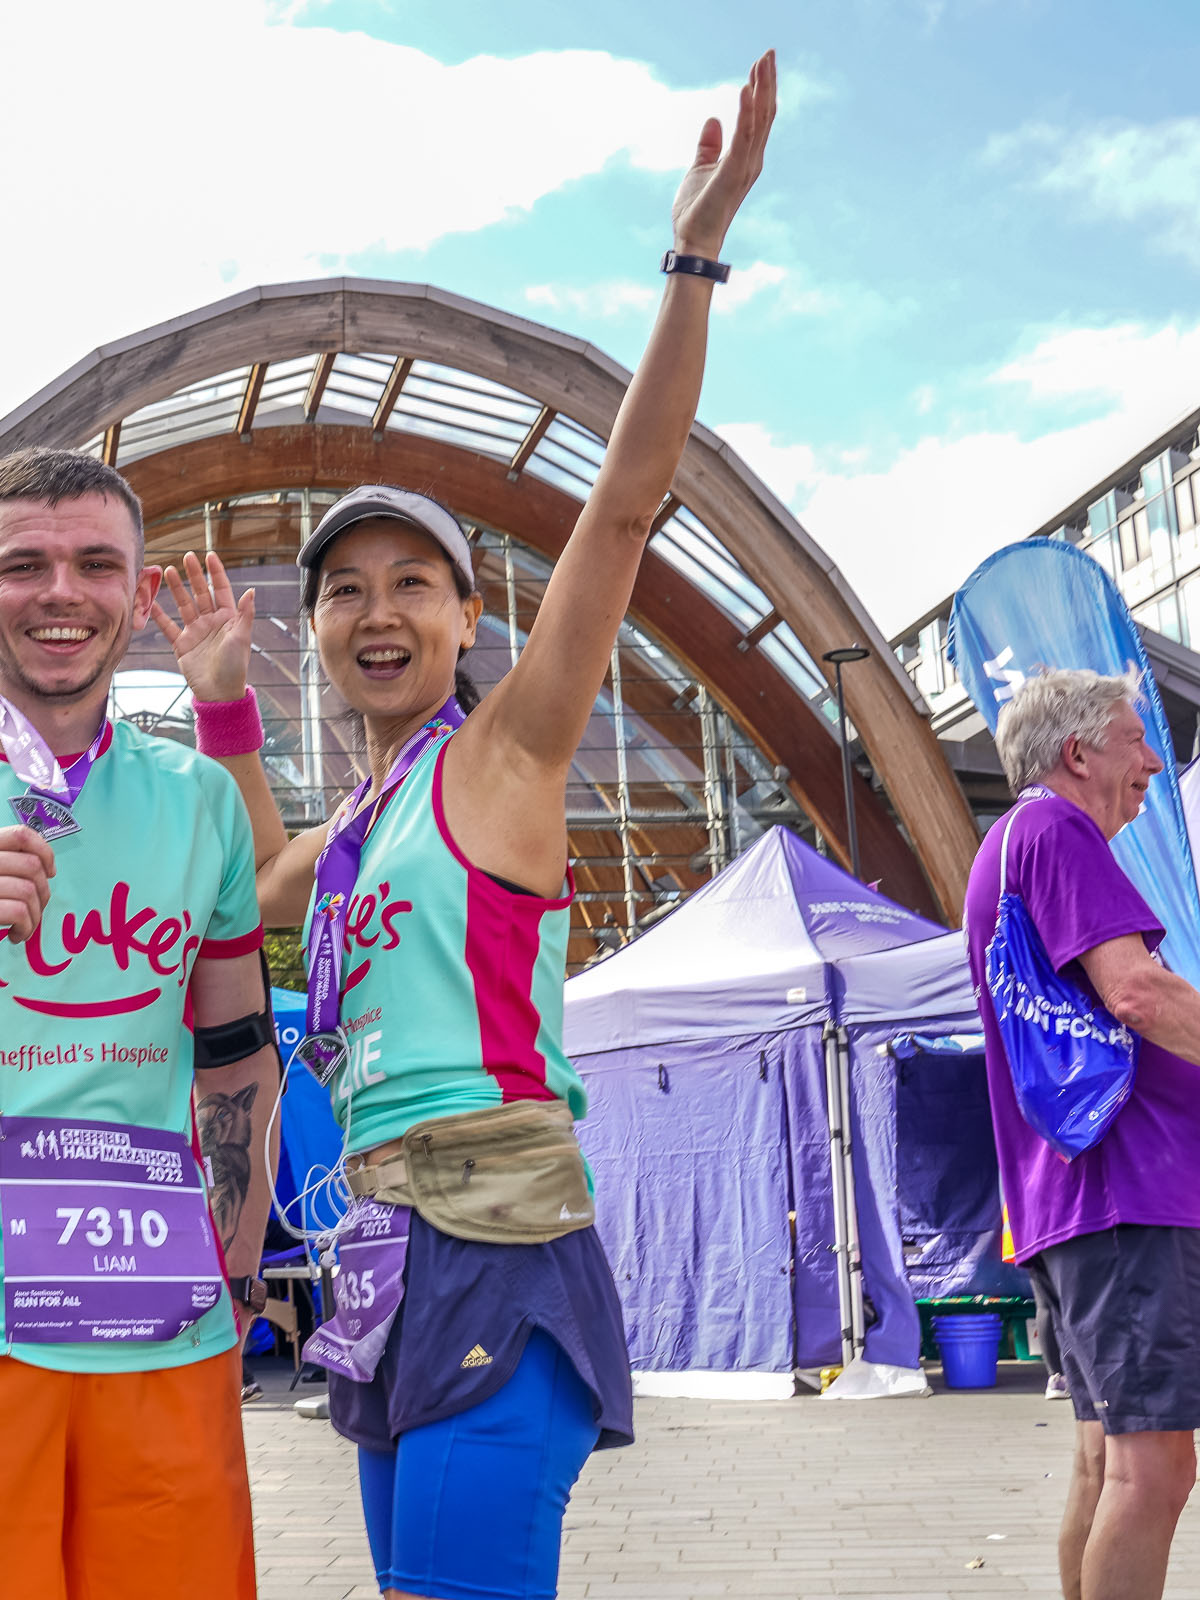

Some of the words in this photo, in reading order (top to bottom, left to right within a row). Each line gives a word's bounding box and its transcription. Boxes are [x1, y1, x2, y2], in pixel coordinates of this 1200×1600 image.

[320, 958, 332, 1001] SHEFFIELD
[101, 1042, 169, 1068] Hospice
[60, 1129, 131, 1147] SHEFFIELD
[63, 1145, 101, 1161] HALF
[100, 1147, 182, 1168] MARATHON
[146, 1166, 183, 1184] 2022
[10, 1218, 26, 1236] M
[55, 1206, 169, 1248] 7310
[93, 1254, 137, 1273] LIAM
[13, 1296, 39, 1308] RUN
[38, 1296, 62, 1308] FOR
[62, 1295, 82, 1307] ALL
[460, 1355, 494, 1369] adidas
